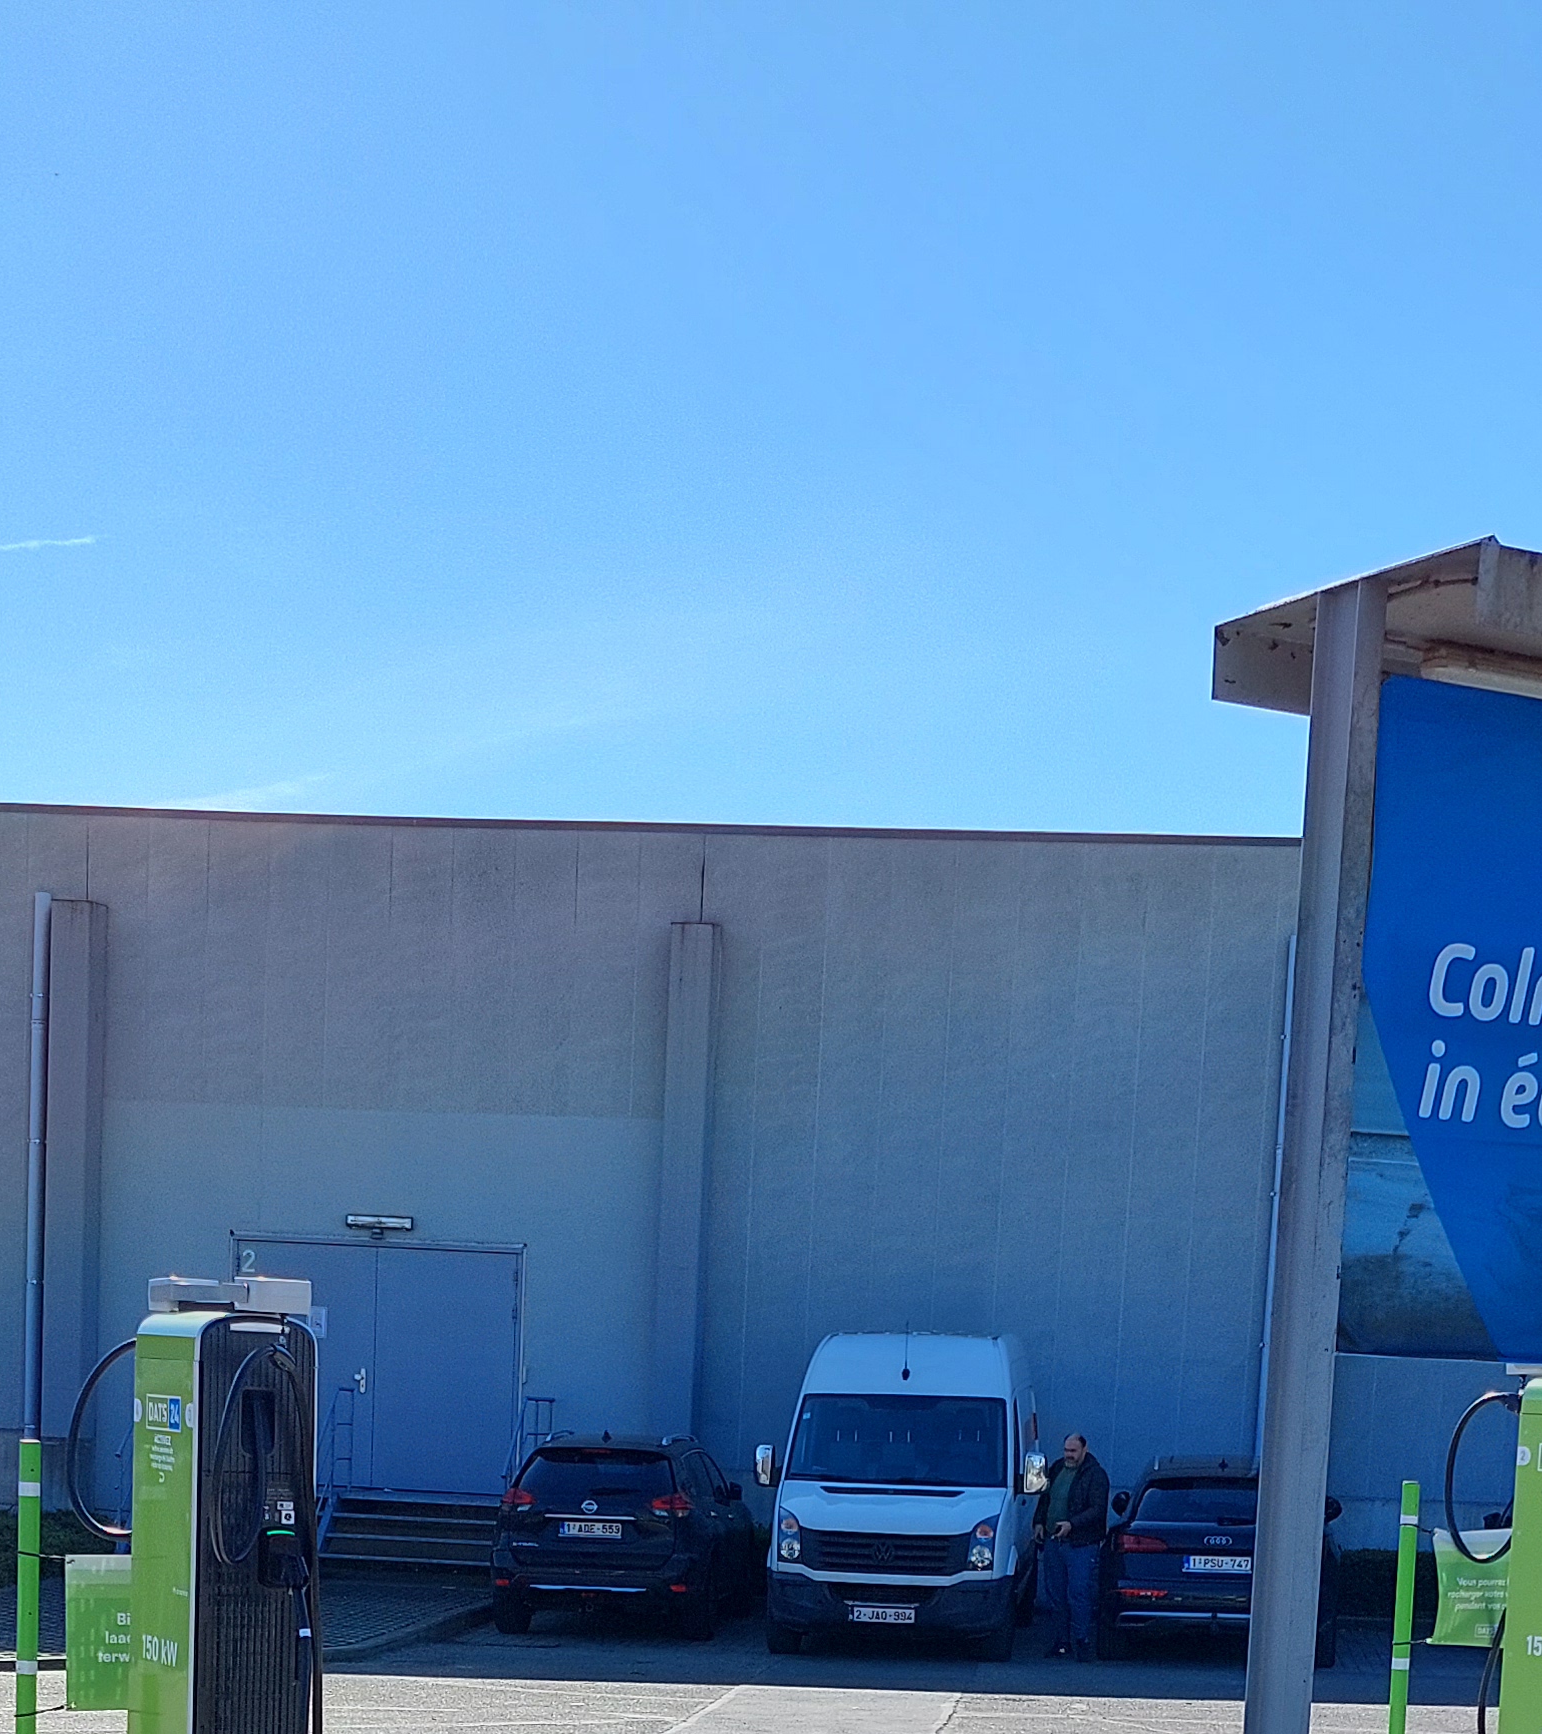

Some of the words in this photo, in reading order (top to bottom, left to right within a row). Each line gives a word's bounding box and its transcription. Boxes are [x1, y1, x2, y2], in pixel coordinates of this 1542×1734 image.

[1418, 1040, 1480, 1123] in
[241, 1250, 256, 1273] 2
[148, 1402, 167, 1423] DATS
[170, 1404, 180, 1424] 24
[142, 1633, 159, 1662] 150
[161, 1638, 178, 1668] kW
